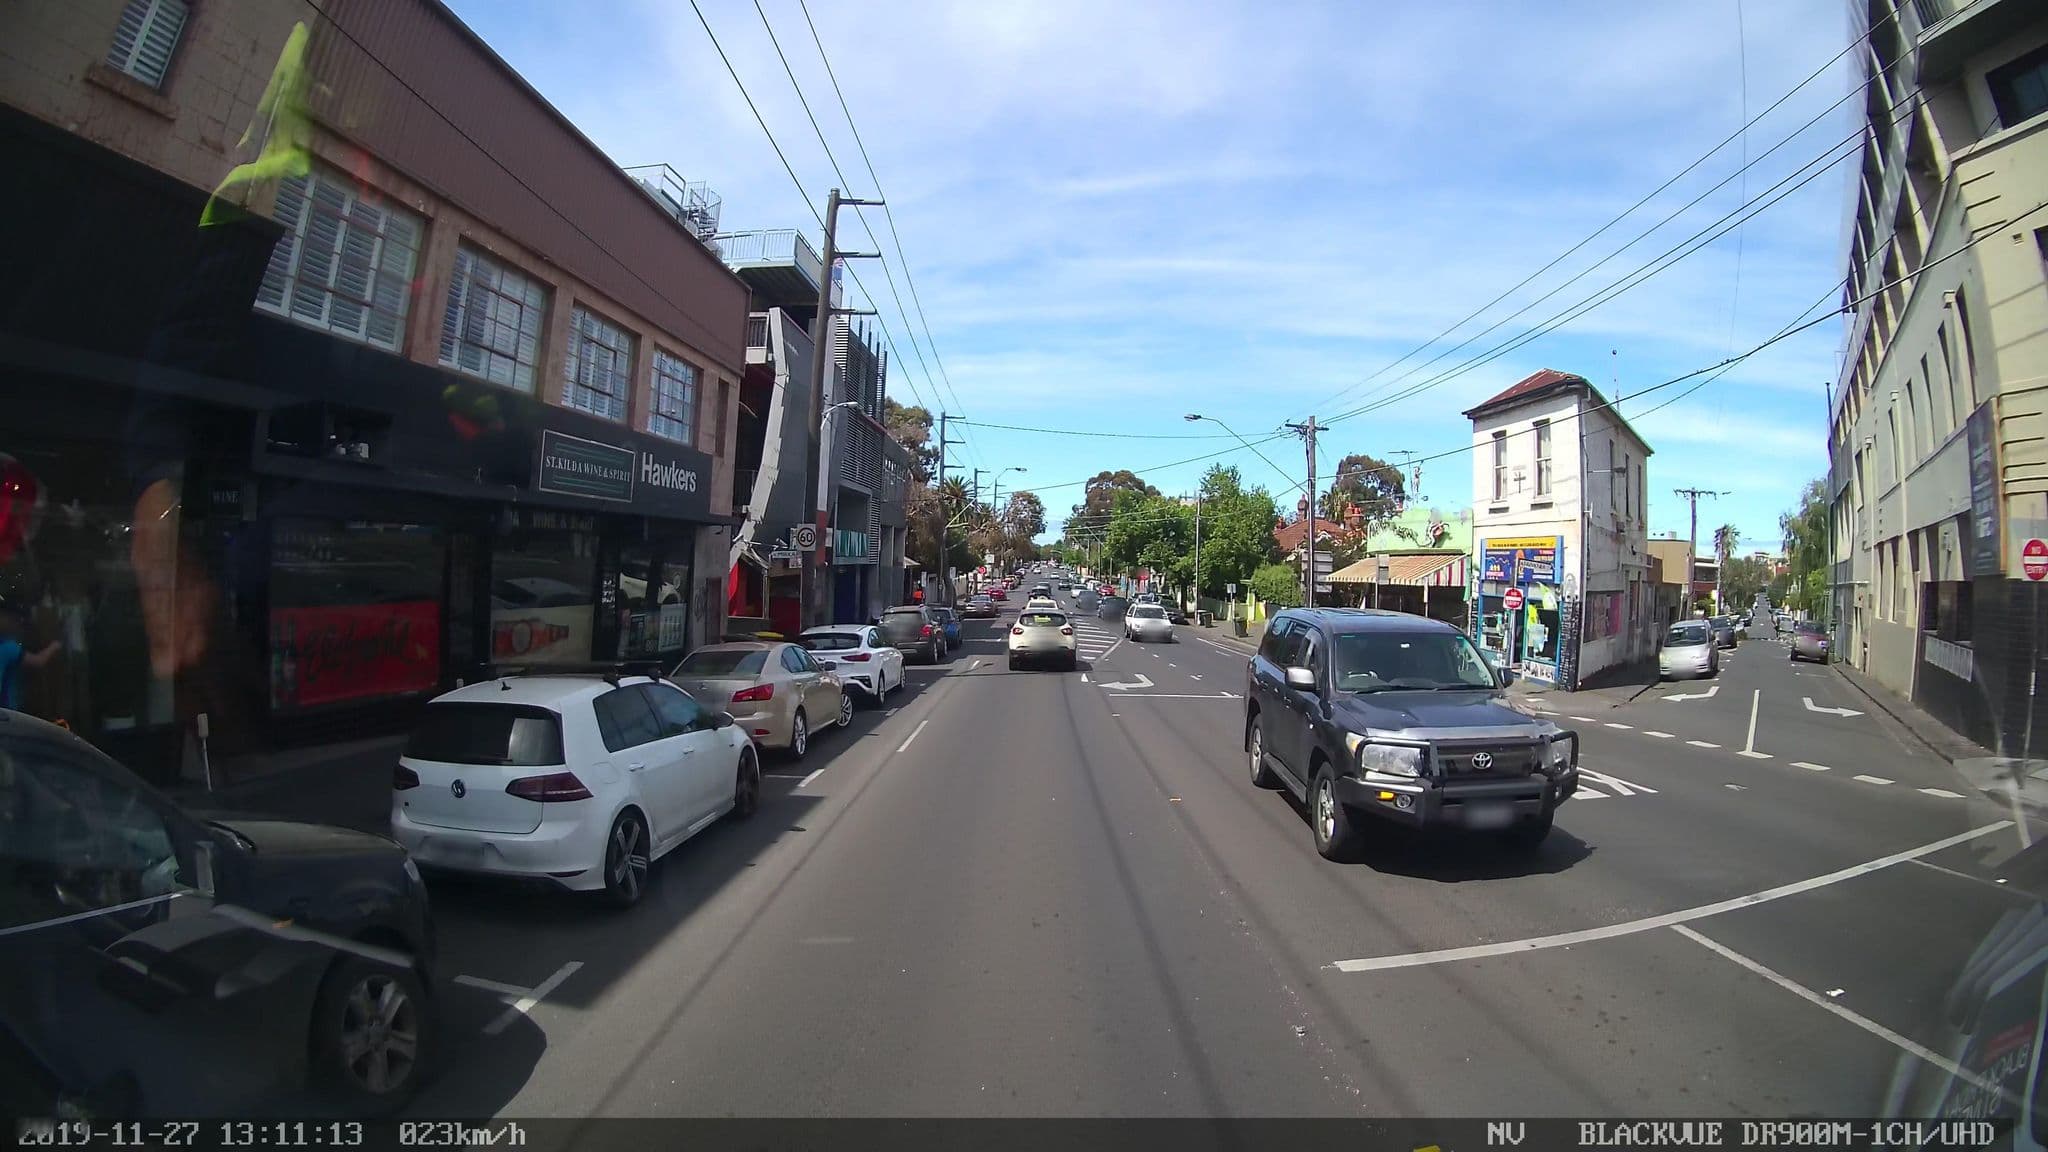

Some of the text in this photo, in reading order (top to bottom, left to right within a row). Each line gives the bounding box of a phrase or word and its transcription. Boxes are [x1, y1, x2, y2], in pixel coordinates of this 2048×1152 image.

[584, 462, 603, 478] WINE
[603, 468, 609, 478] &
[641, 452, 697, 493] Hawkers
[800, 532, 813, 543] 60
[2031, 546, 2041, 555] NO
[2026, 565, 2047, 575] ENTRY
